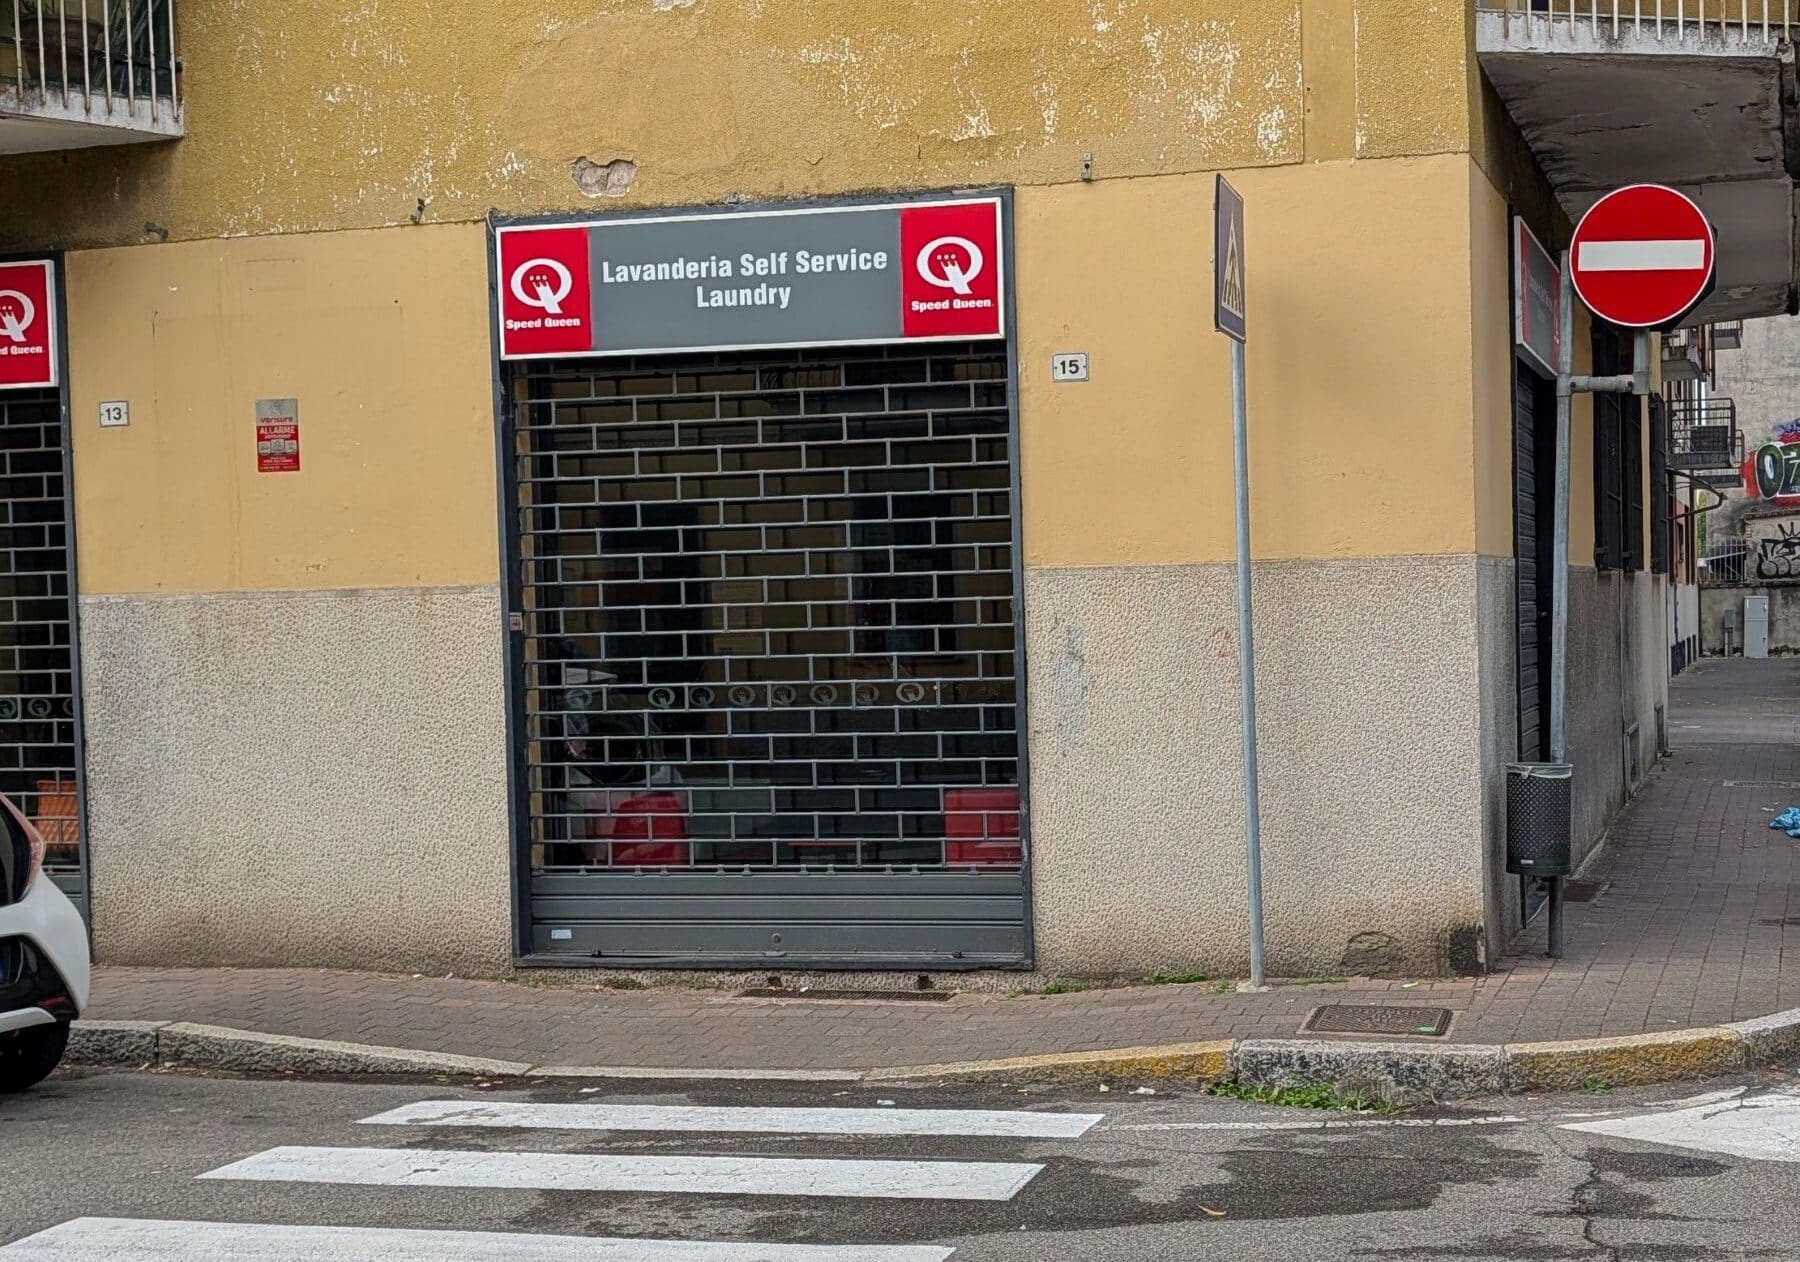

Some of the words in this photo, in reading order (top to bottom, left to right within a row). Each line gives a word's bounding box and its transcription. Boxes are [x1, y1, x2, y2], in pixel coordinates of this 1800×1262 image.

[602, 256, 732, 283] Lavanderia
[740, 252, 788, 277] Self
[795, 248, 888, 274] Service
[696, 282, 792, 309] Laundry
[911, 299, 950, 312] Speed
[952, 298, 992, 309] Queen
[506, 318, 541, 331] Speed
[544, 317, 580, 328] Queen
[10, 345, 43, 355] Queen
[1060, 359, 1080, 375] 15
[105, 407, 122, 421] 13
[260, 416, 293, 424] verisure
[260, 426, 296, 435] ALLARME
